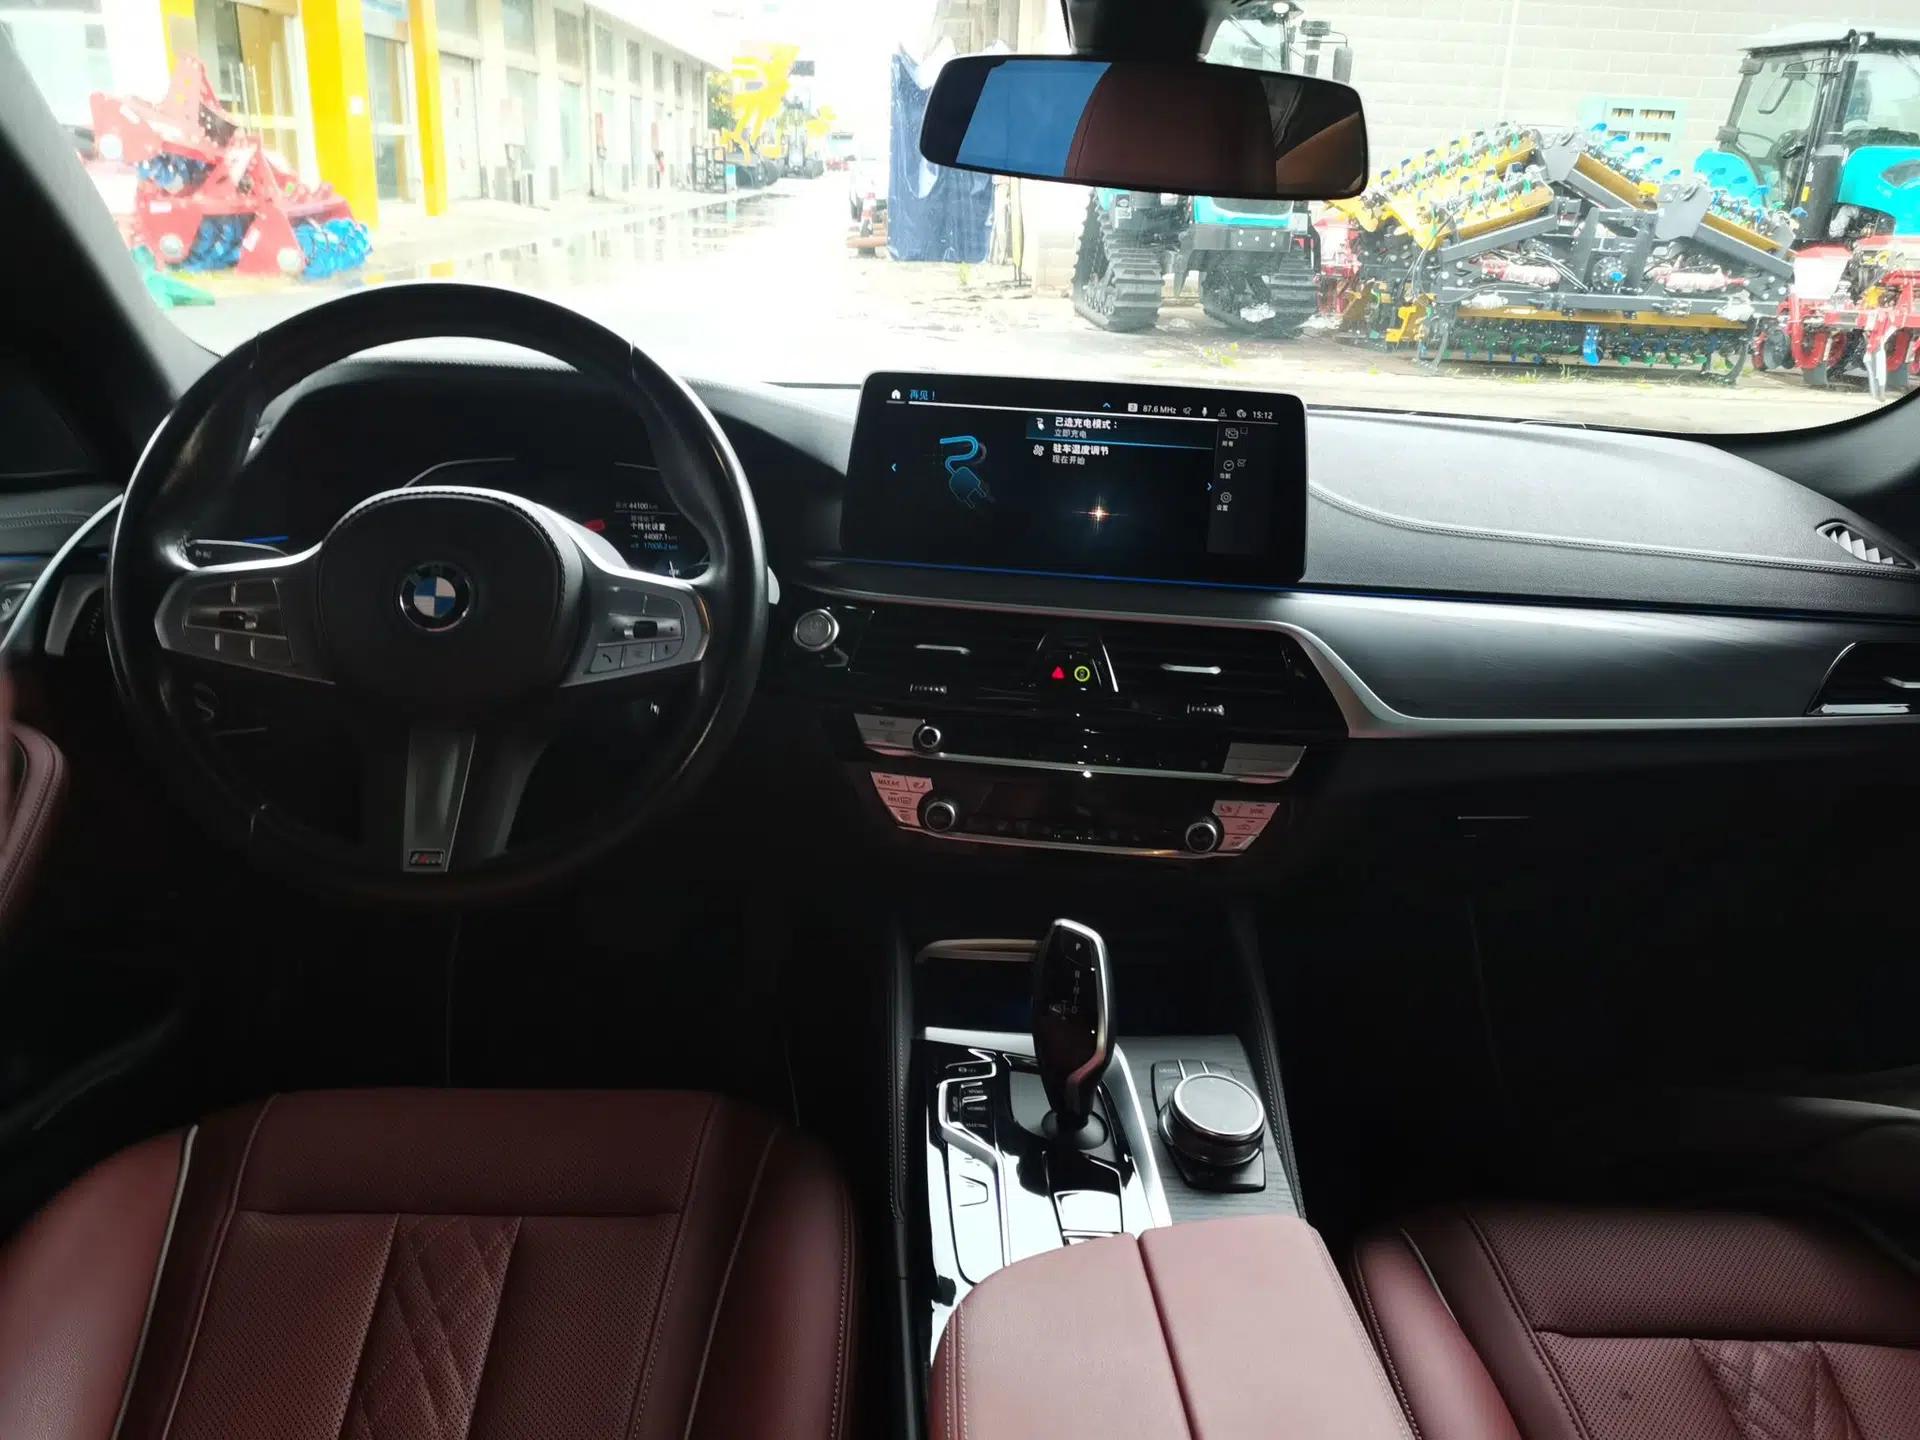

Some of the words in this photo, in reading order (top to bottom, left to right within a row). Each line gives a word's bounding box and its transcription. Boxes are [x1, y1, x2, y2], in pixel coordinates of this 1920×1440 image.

[1142, 405, 1158, 413] 87.6
[1160, 406, 1177, 415] MHz
[1253, 411, 1273, 420] 15:12
[1052, 454, 1086, 466] 现在开始
